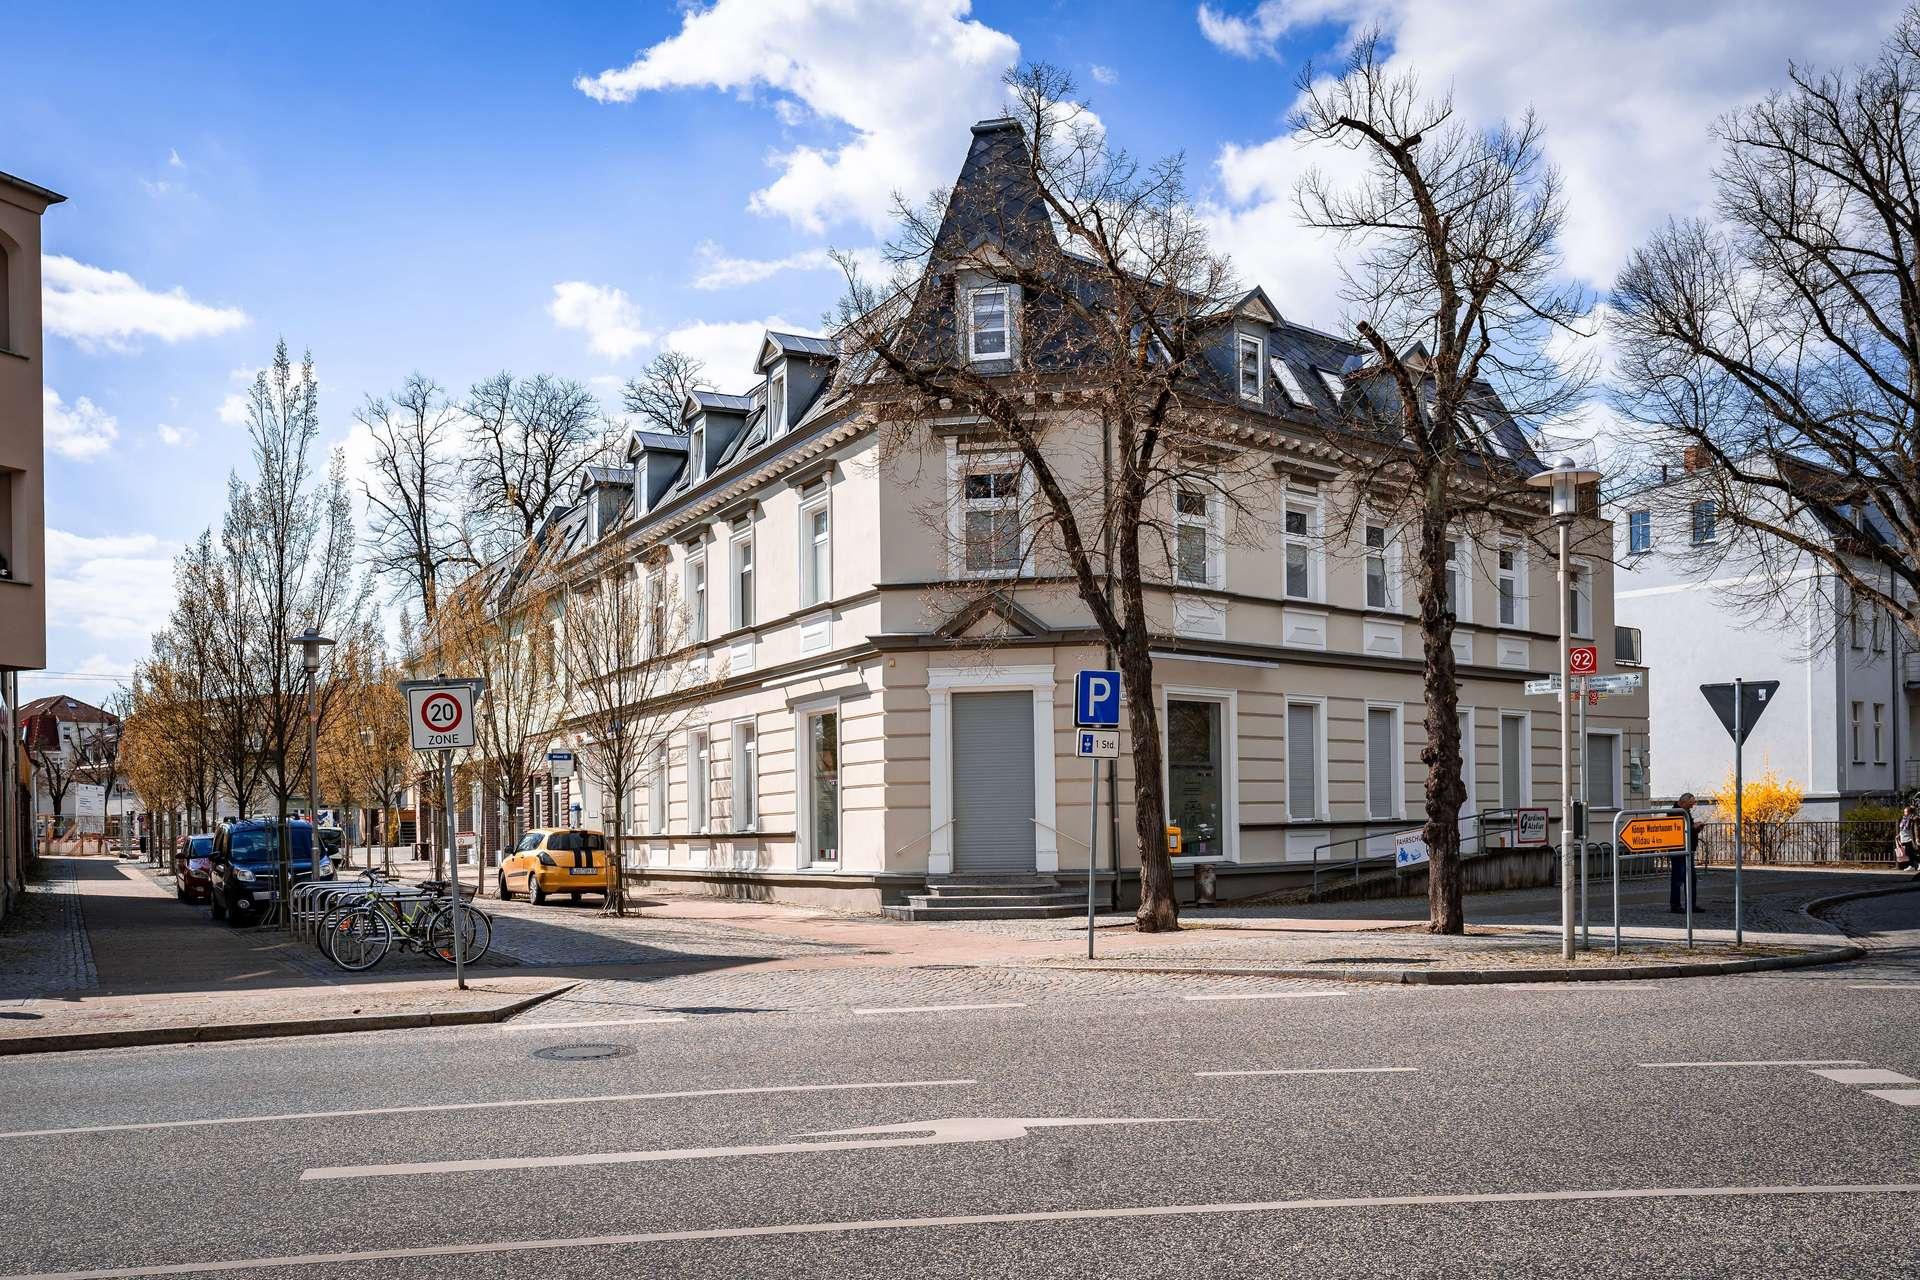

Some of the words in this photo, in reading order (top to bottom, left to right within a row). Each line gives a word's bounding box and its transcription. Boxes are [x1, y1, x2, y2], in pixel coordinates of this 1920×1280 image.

[1573, 652, 1591, 667] 92
[1088, 677, 1111, 717] P
[430, 703, 454, 722] 20
[428, 734, 459, 745] ZONE
[1095, 740, 1099, 749] 1
[1396, 834, 1422, 847] FAHRSCHU
[1632, 836, 1650, 845] Wildau
